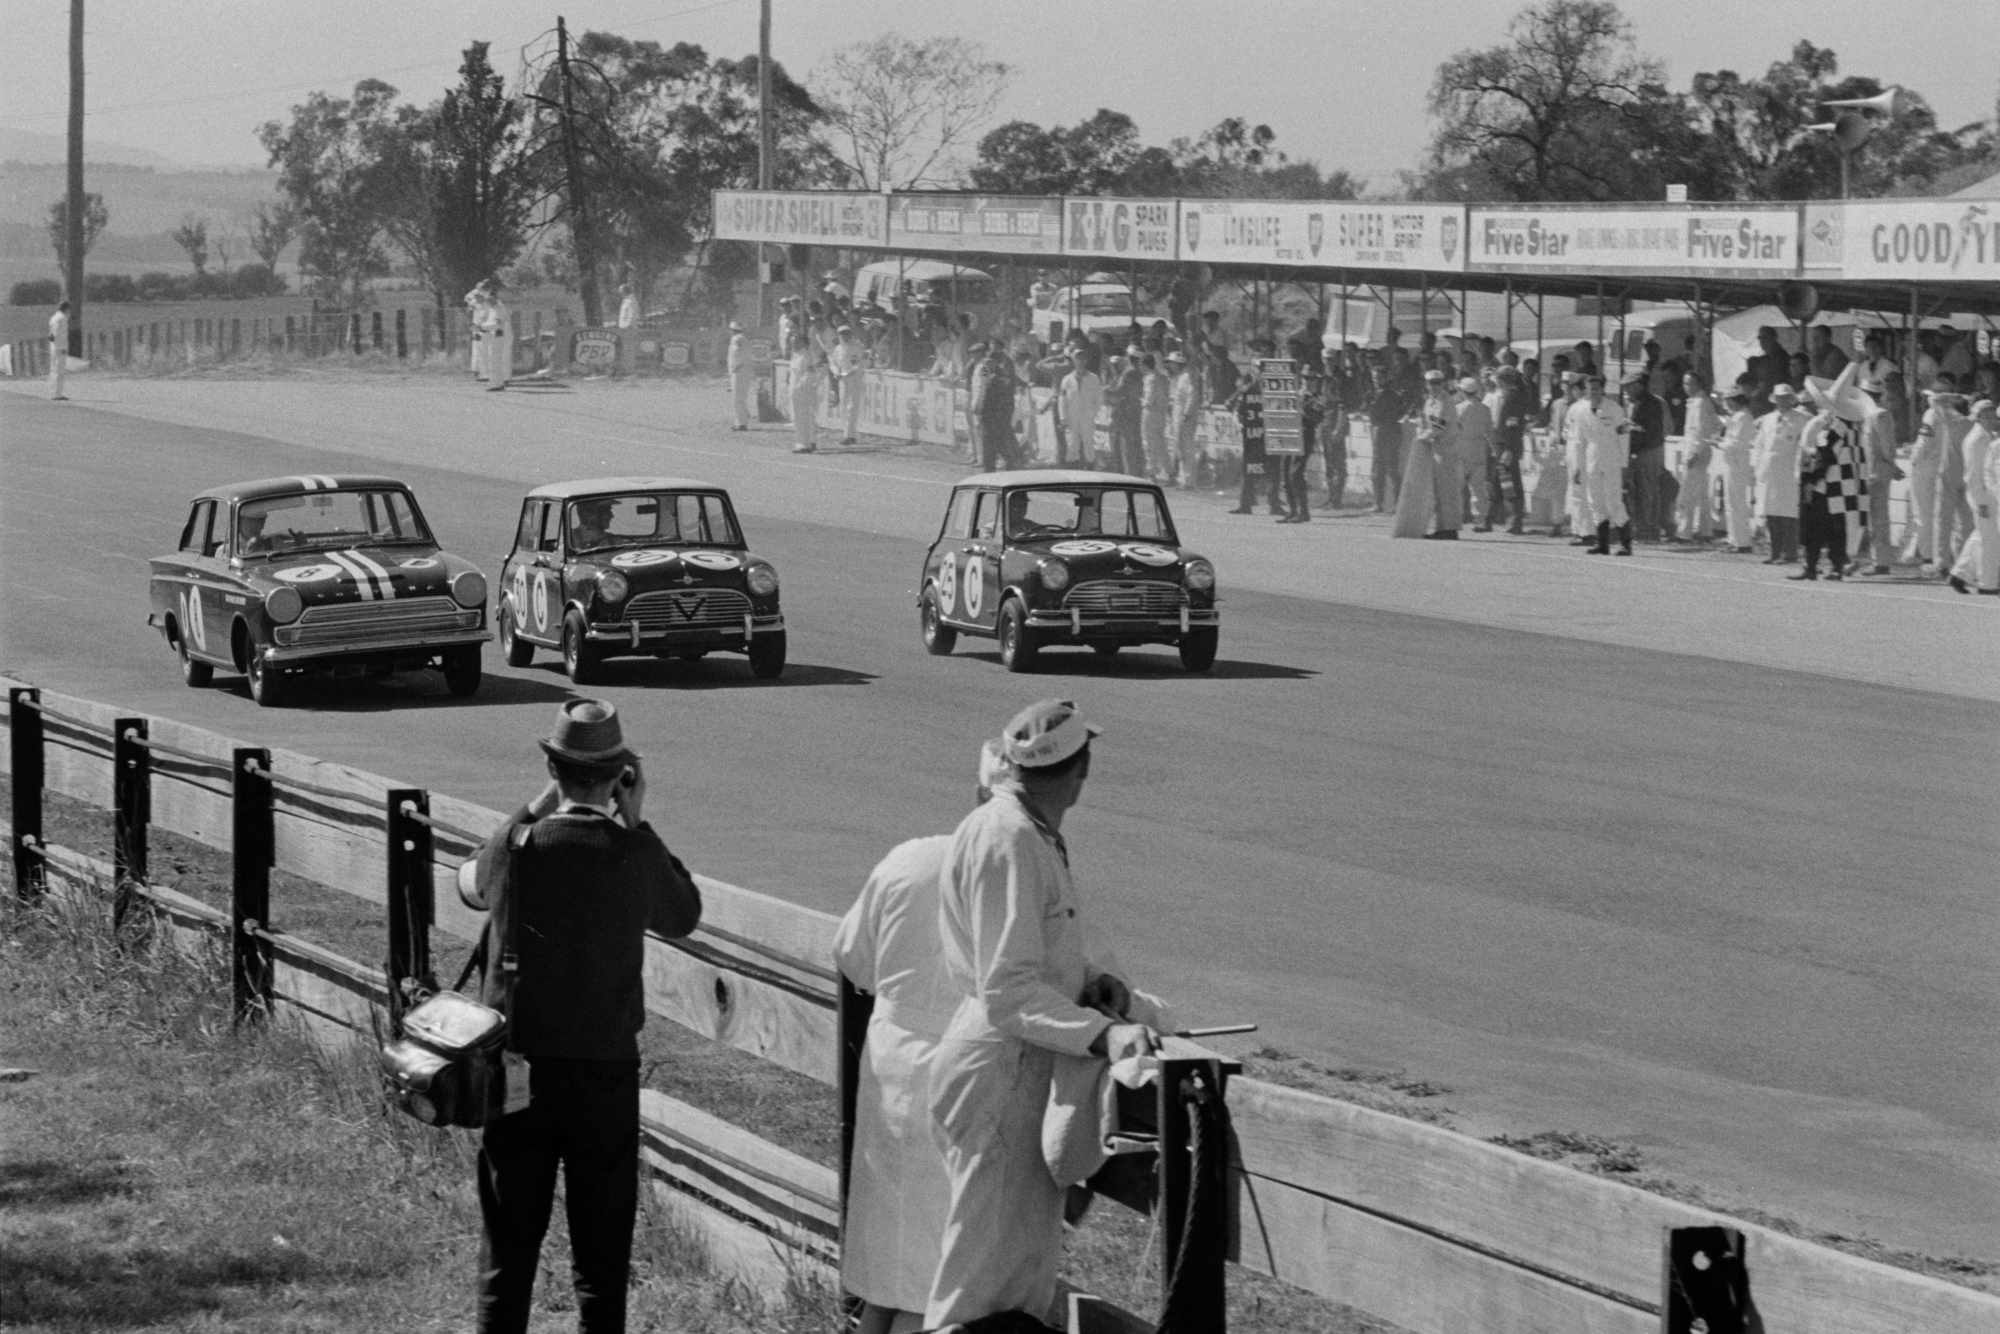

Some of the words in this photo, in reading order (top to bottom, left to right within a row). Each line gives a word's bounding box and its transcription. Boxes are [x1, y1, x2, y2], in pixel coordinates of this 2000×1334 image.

[1136, 205, 1168, 226] SPARK
[1340, 213, 1384, 247] SUPER
[1138, 231, 1168, 251] PLUGS
[1485, 218, 1524, 256] Five
[1527, 218, 1569, 257] Star
[1687, 218, 1733, 258] Five
[1738, 218, 1786, 260] Star
[968, 565, 979, 610] C
